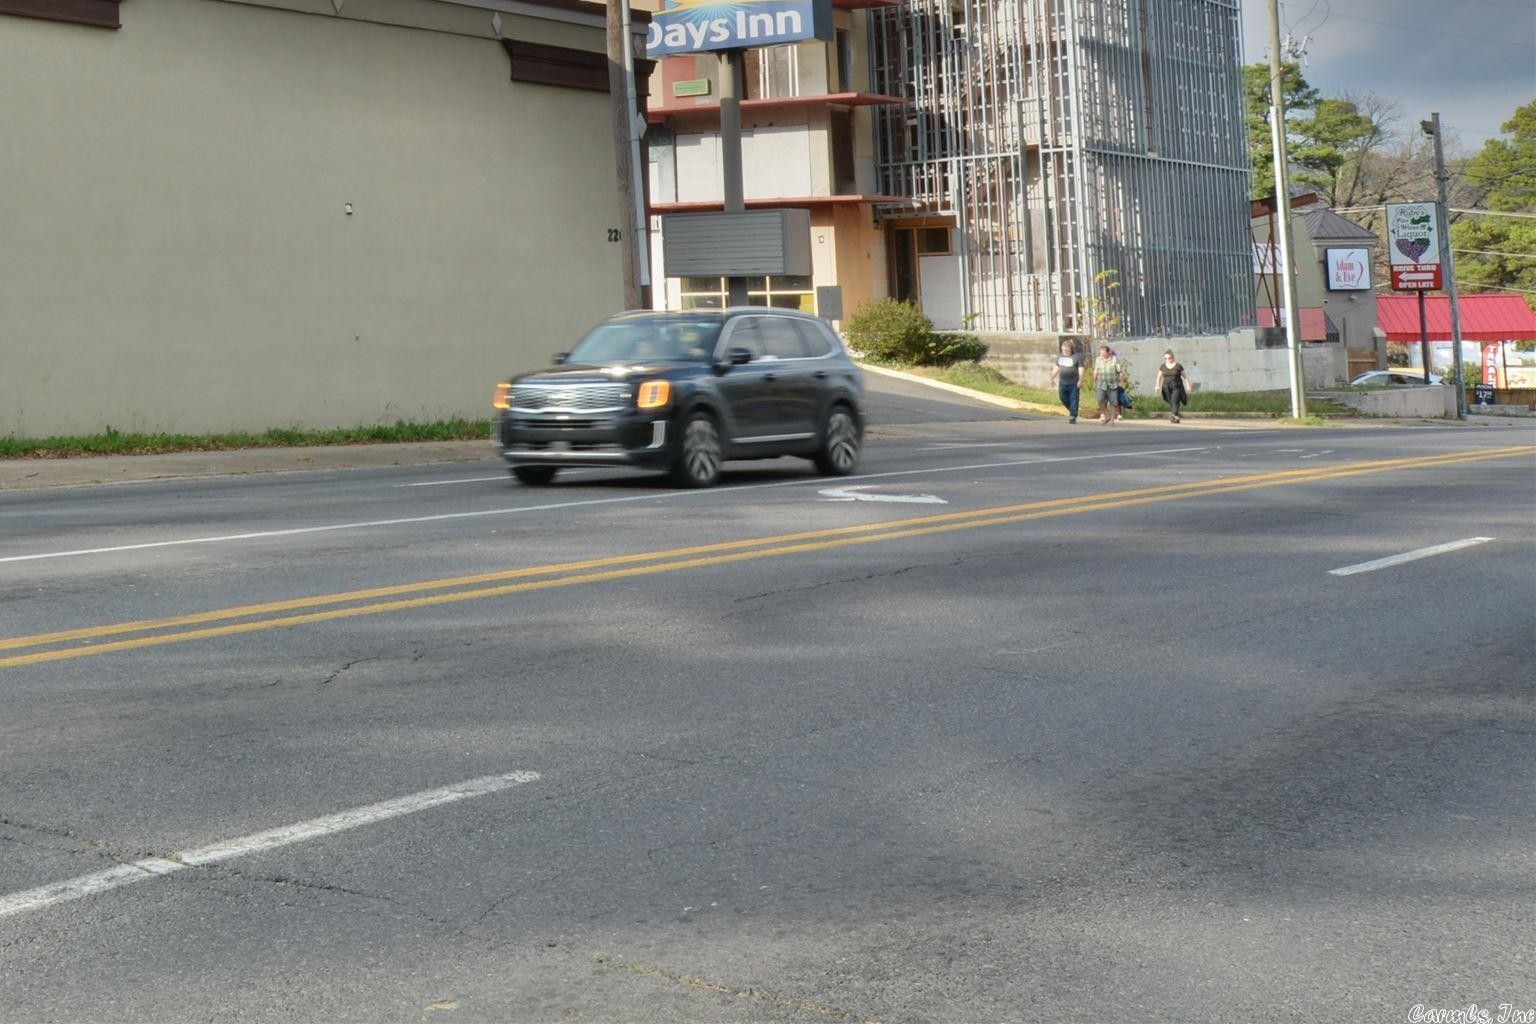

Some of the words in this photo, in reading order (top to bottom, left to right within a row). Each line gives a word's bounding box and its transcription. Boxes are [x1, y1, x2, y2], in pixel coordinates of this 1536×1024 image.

[647, 18, 730, 50] Days
[736, 9, 802, 40] Inn
[607, 228, 623, 242] 22
[1397, 230, 1427, 240] Liquor
[1336, 259, 1354, 271] Adam
[1399, 280, 1417, 288] OPEN
[1418, 280, 1435, 288] LATE
